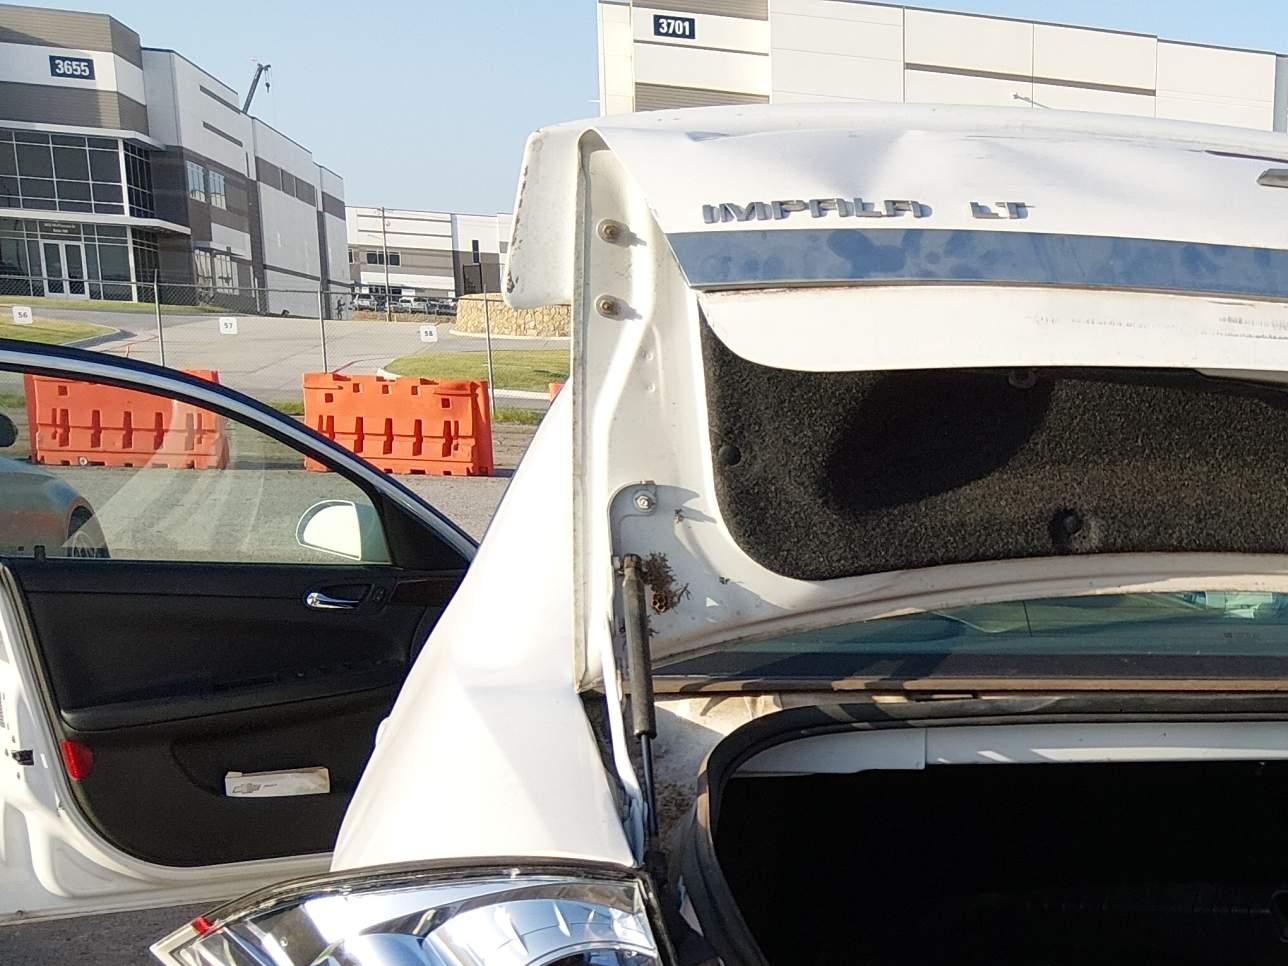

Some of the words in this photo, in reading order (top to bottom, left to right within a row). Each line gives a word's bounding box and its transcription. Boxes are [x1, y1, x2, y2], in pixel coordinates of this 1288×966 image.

[658, 18, 690, 36] 3701
[54, 59, 90, 76] 3655
[702, 197, 929, 224] IMPALA
[969, 201, 1034, 220] LT
[17, 311, 29, 319] 56
